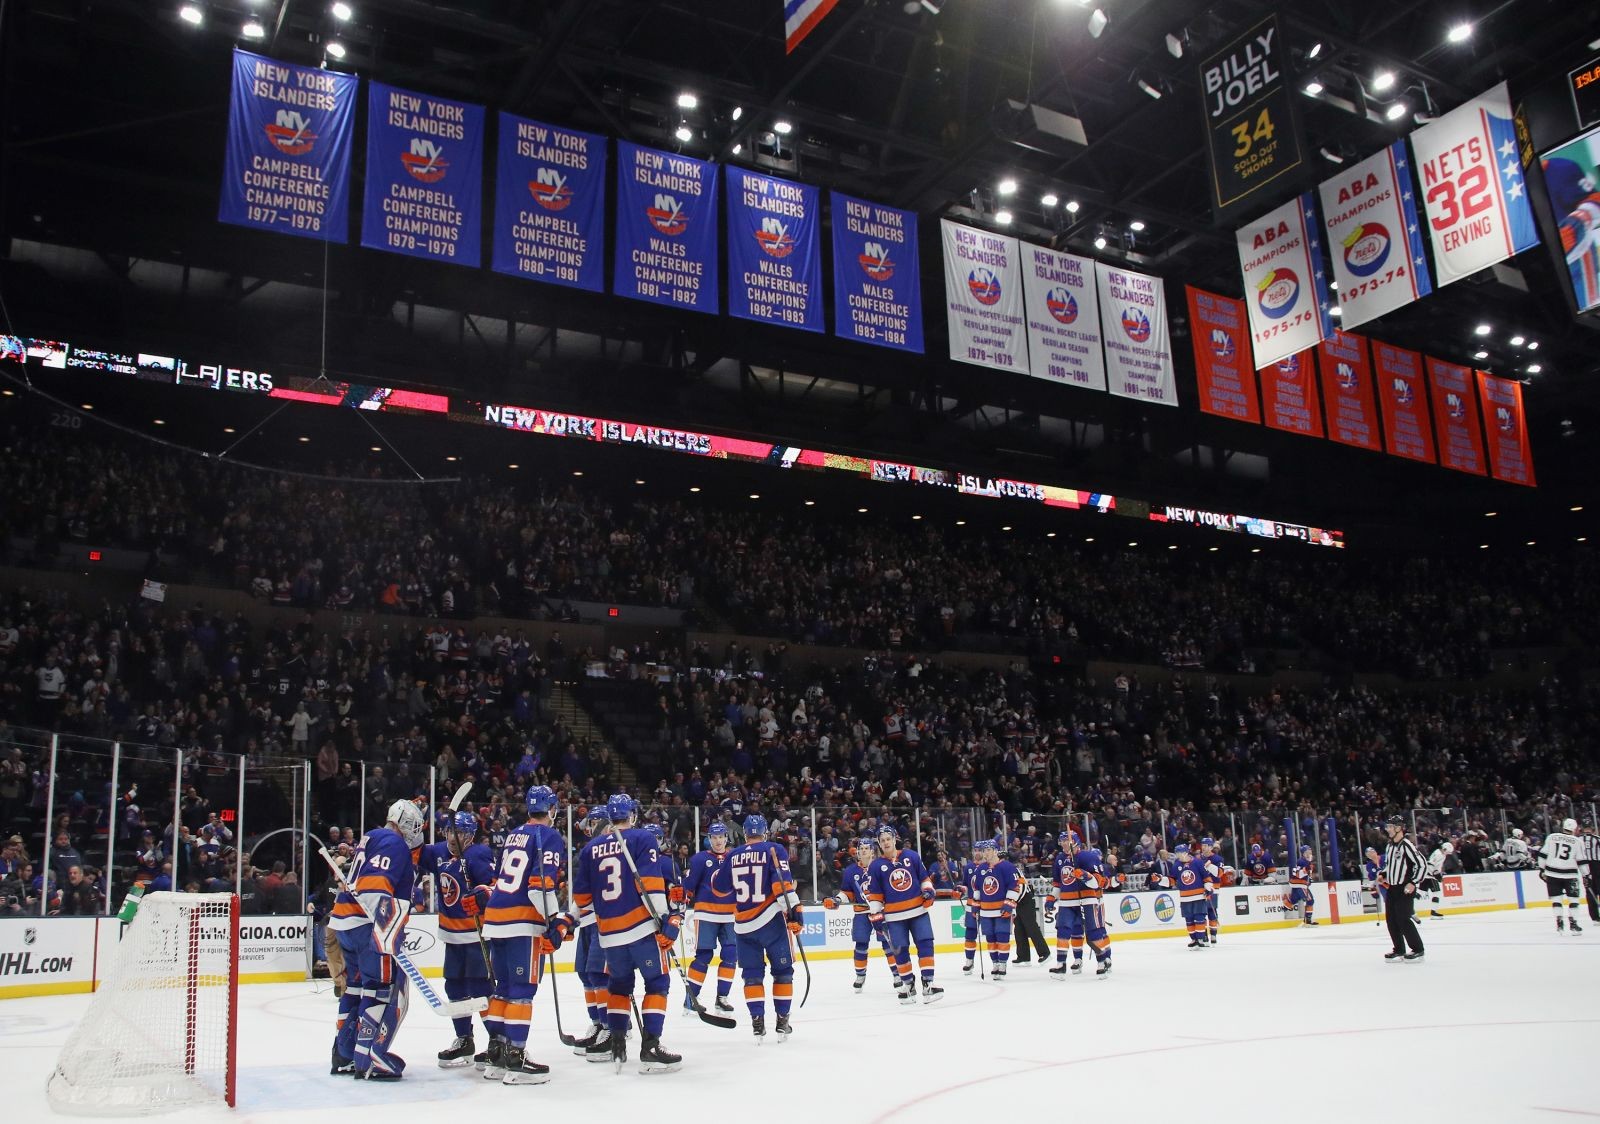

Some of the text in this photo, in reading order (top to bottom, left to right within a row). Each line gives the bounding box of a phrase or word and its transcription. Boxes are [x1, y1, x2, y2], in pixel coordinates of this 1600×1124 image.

[1205, 28, 1274, 94] BILLY
[256, 62, 336, 93] NEW YORK
[1212, 60, 1279, 117] JOEL
[254, 81, 336, 112] ISLANDERS
[390, 93, 464, 122] NEW YORK
[389, 110, 464, 140] ISLANDERS
[1232, 107, 1274, 158] 34
[518, 123, 587, 153] NEW YORK
[518, 140, 587, 170] ISLANDERS
[636, 150, 701, 179] NEW YORK
[1234, 140, 1278, 173] SOLD OUT
[1242, 155, 1273, 179] SHOWS
[1424, 136, 1482, 187] NETS
[253, 156, 323, 182] CAMPBELL
[244, 171, 329, 199] CONFERENCE
[636, 168, 702, 196] ISLANDERS
[743, 176, 802, 202] NEW YORK
[1338, 172, 1379, 205] ABA
[247, 189, 324, 215] CHAMPIONS
[392, 184, 455, 209] CAMPBELL
[743, 193, 804, 218] ISLANDERS
[1327, 189, 1391, 228] CHAMPIONS
[1427, 164, 1493, 232] 32
[384, 199, 462, 226] CONFERENCE
[520, 211, 580, 236] CAMPBELL
[847, 201, 902, 227] NEW YORK
[386, 216, 458, 240] CHAMPIONS
[512, 226, 586, 252] CONFERENCE
[848, 218, 904, 243] ISLANDERS
[956, 229, 1005, 252] NEW YORK
[1253, 221, 1289, 250] ABA
[1444, 216, 1491, 253] ERVING
[515, 242, 582, 267] CHAMPIONS
[650, 238, 686, 257] WALES
[958, 245, 1007, 268] ISLANDERS
[1244, 238, 1300, 272] CHAMPIONS
[633, 250, 702, 275] CONFERENCE
[759, 260, 792, 278] WALES
[1034, 250, 1081, 274] NEW YORK
[635, 266, 699, 290] CHAMPIONS
[744, 273, 808, 296] CONFERENCE
[1036, 265, 1083, 288] ISLANDERS
[1109, 272, 1152, 292] NEW YORK
[1341, 266, 1405, 303] 1973-74
[748, 288, 806, 310] CHAMPIONS
[863, 284, 893, 300] WALES
[1111, 286, 1154, 307] ISLANDERS
[849, 294, 908, 317] CONFERENCE
[951, 303, 977, 316] NATIONAL
[852, 310, 906, 331] CHAMPIONS
[1030, 321, 1055, 334] NATIONAL
[1256, 310, 1312, 343] 1975-76
[973, 336, 1005, 348] CHAMPIONS
[1107, 341, 1130, 352] NATIONAL
[1052, 353, 1082, 366] CHAMPIONS
[1128, 371, 1156, 383] CHAMPIONS
[50, 412, 80, 428] 220
[485, 406, 712, 454] NEW YORK ISLANDERS
[873, 462, 911, 481] NEW
[961, 475, 1046, 500] ISLANDERS
[1166, 507, 1195, 522] NEW
[1198, 511, 1230, 528] YORK
[1276, 525, 1283, 536] 3
[222, 810, 235, 821] EXIT
[370, 855, 390, 870] 40
[544, 851, 560, 866] 29
[649, 849, 656, 862] 3
[904, 858, 910, 866] C
[1556, 843, 1571, 860] 13
[497, 849, 529, 894] 9
[599, 857, 622, 900] 3
[732, 866, 766, 902] 51
[800, 923, 822, 935] HSS
